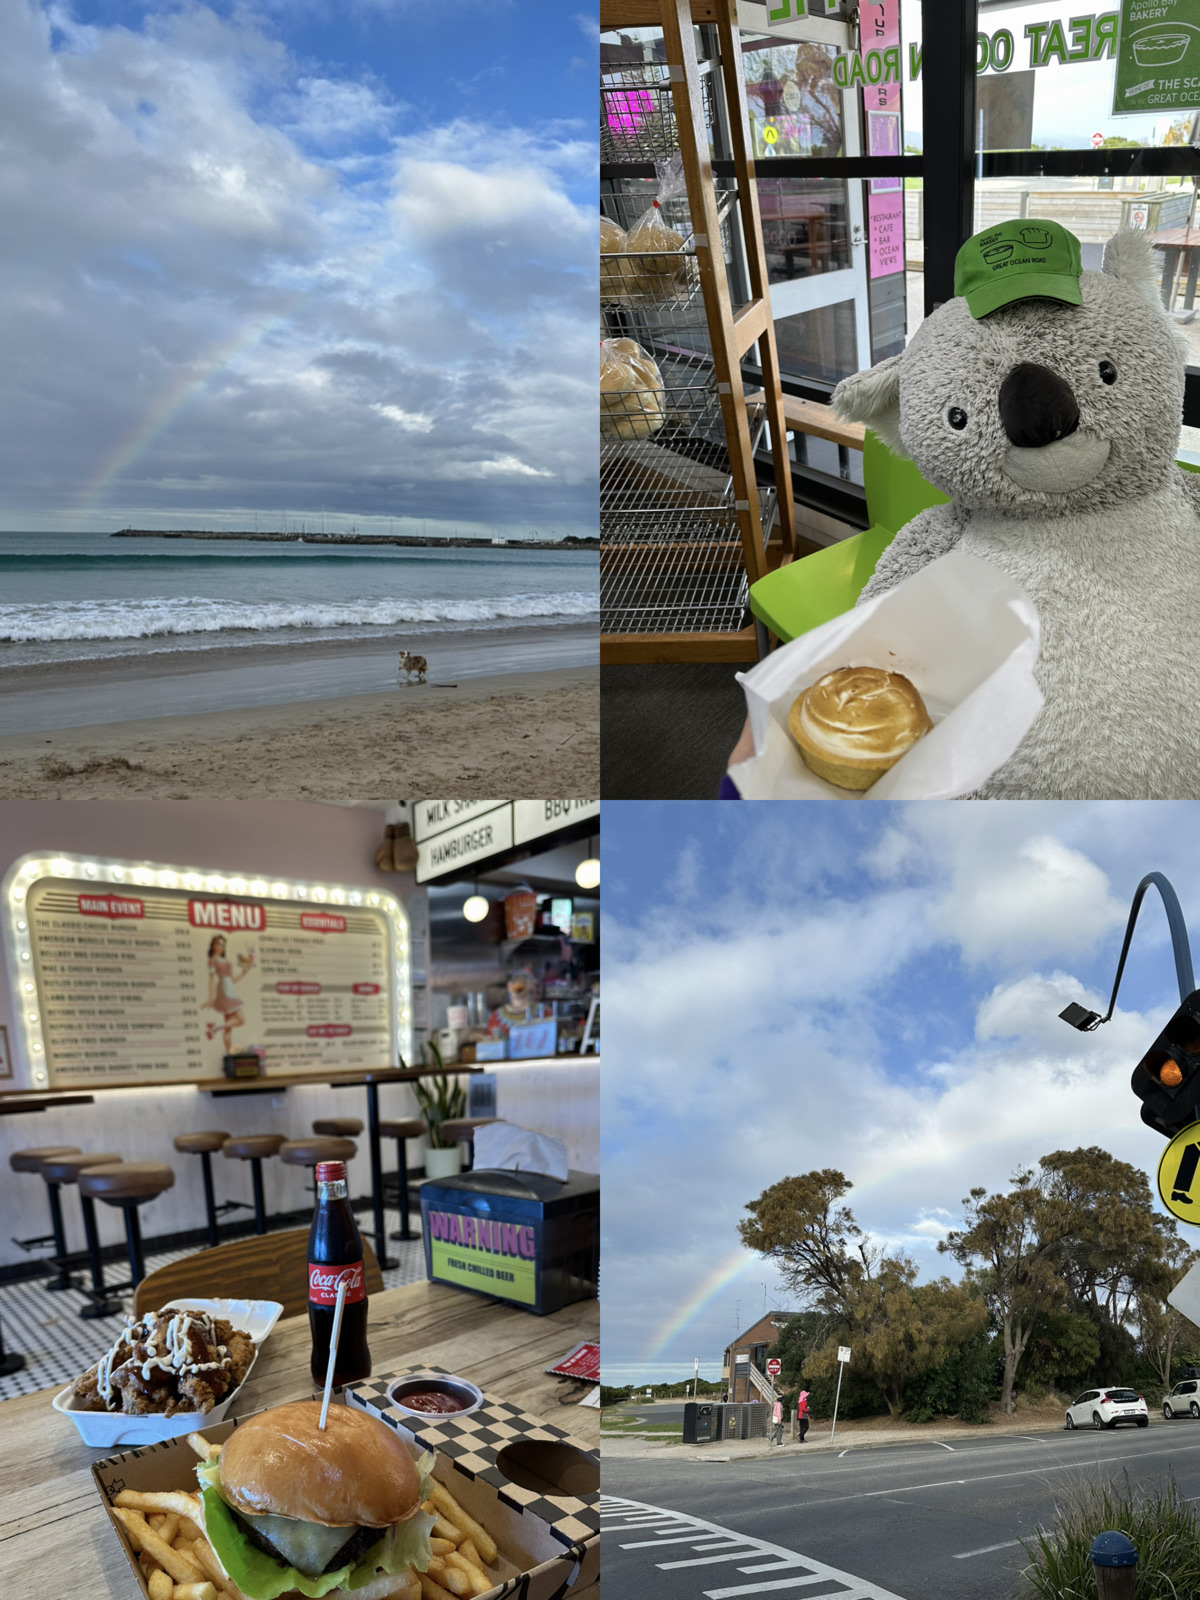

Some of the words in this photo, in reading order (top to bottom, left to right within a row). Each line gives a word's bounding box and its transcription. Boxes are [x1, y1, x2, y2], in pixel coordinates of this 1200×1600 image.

[1130, 0, 1159, 11] Apollo
[1130, 7, 1168, 21] BAKERY
[1158, 79, 1180, 90] THE
[1147, 93, 1178, 104] GREAT
[1180, 91, 1200, 102] OCE
[873, 211, 902, 222] RESTAURANT
[878, 224, 894, 234] CAFE
[879, 236, 891, 245] BAR
[879, 245, 900, 256] OCEAN
[879, 256, 898, 267] VIEWS
[992, 260, 1009, 271] GREAT
[1010, 257, 1031, 266] OCEAN
[427, 801, 451, 828] MILK
[431, 825, 494, 868] HAMBURGER
[80, 899, 109, 912] MAIN
[110, 902, 142, 915] EVENT
[193, 902, 262, 929] MENU
[429, 1211, 535, 1262] WARNING
[447, 1257, 467, 1271] FRESH
[467, 1262, 495, 1279] CHILLED
[495, 1269, 515, 1283] BEER
